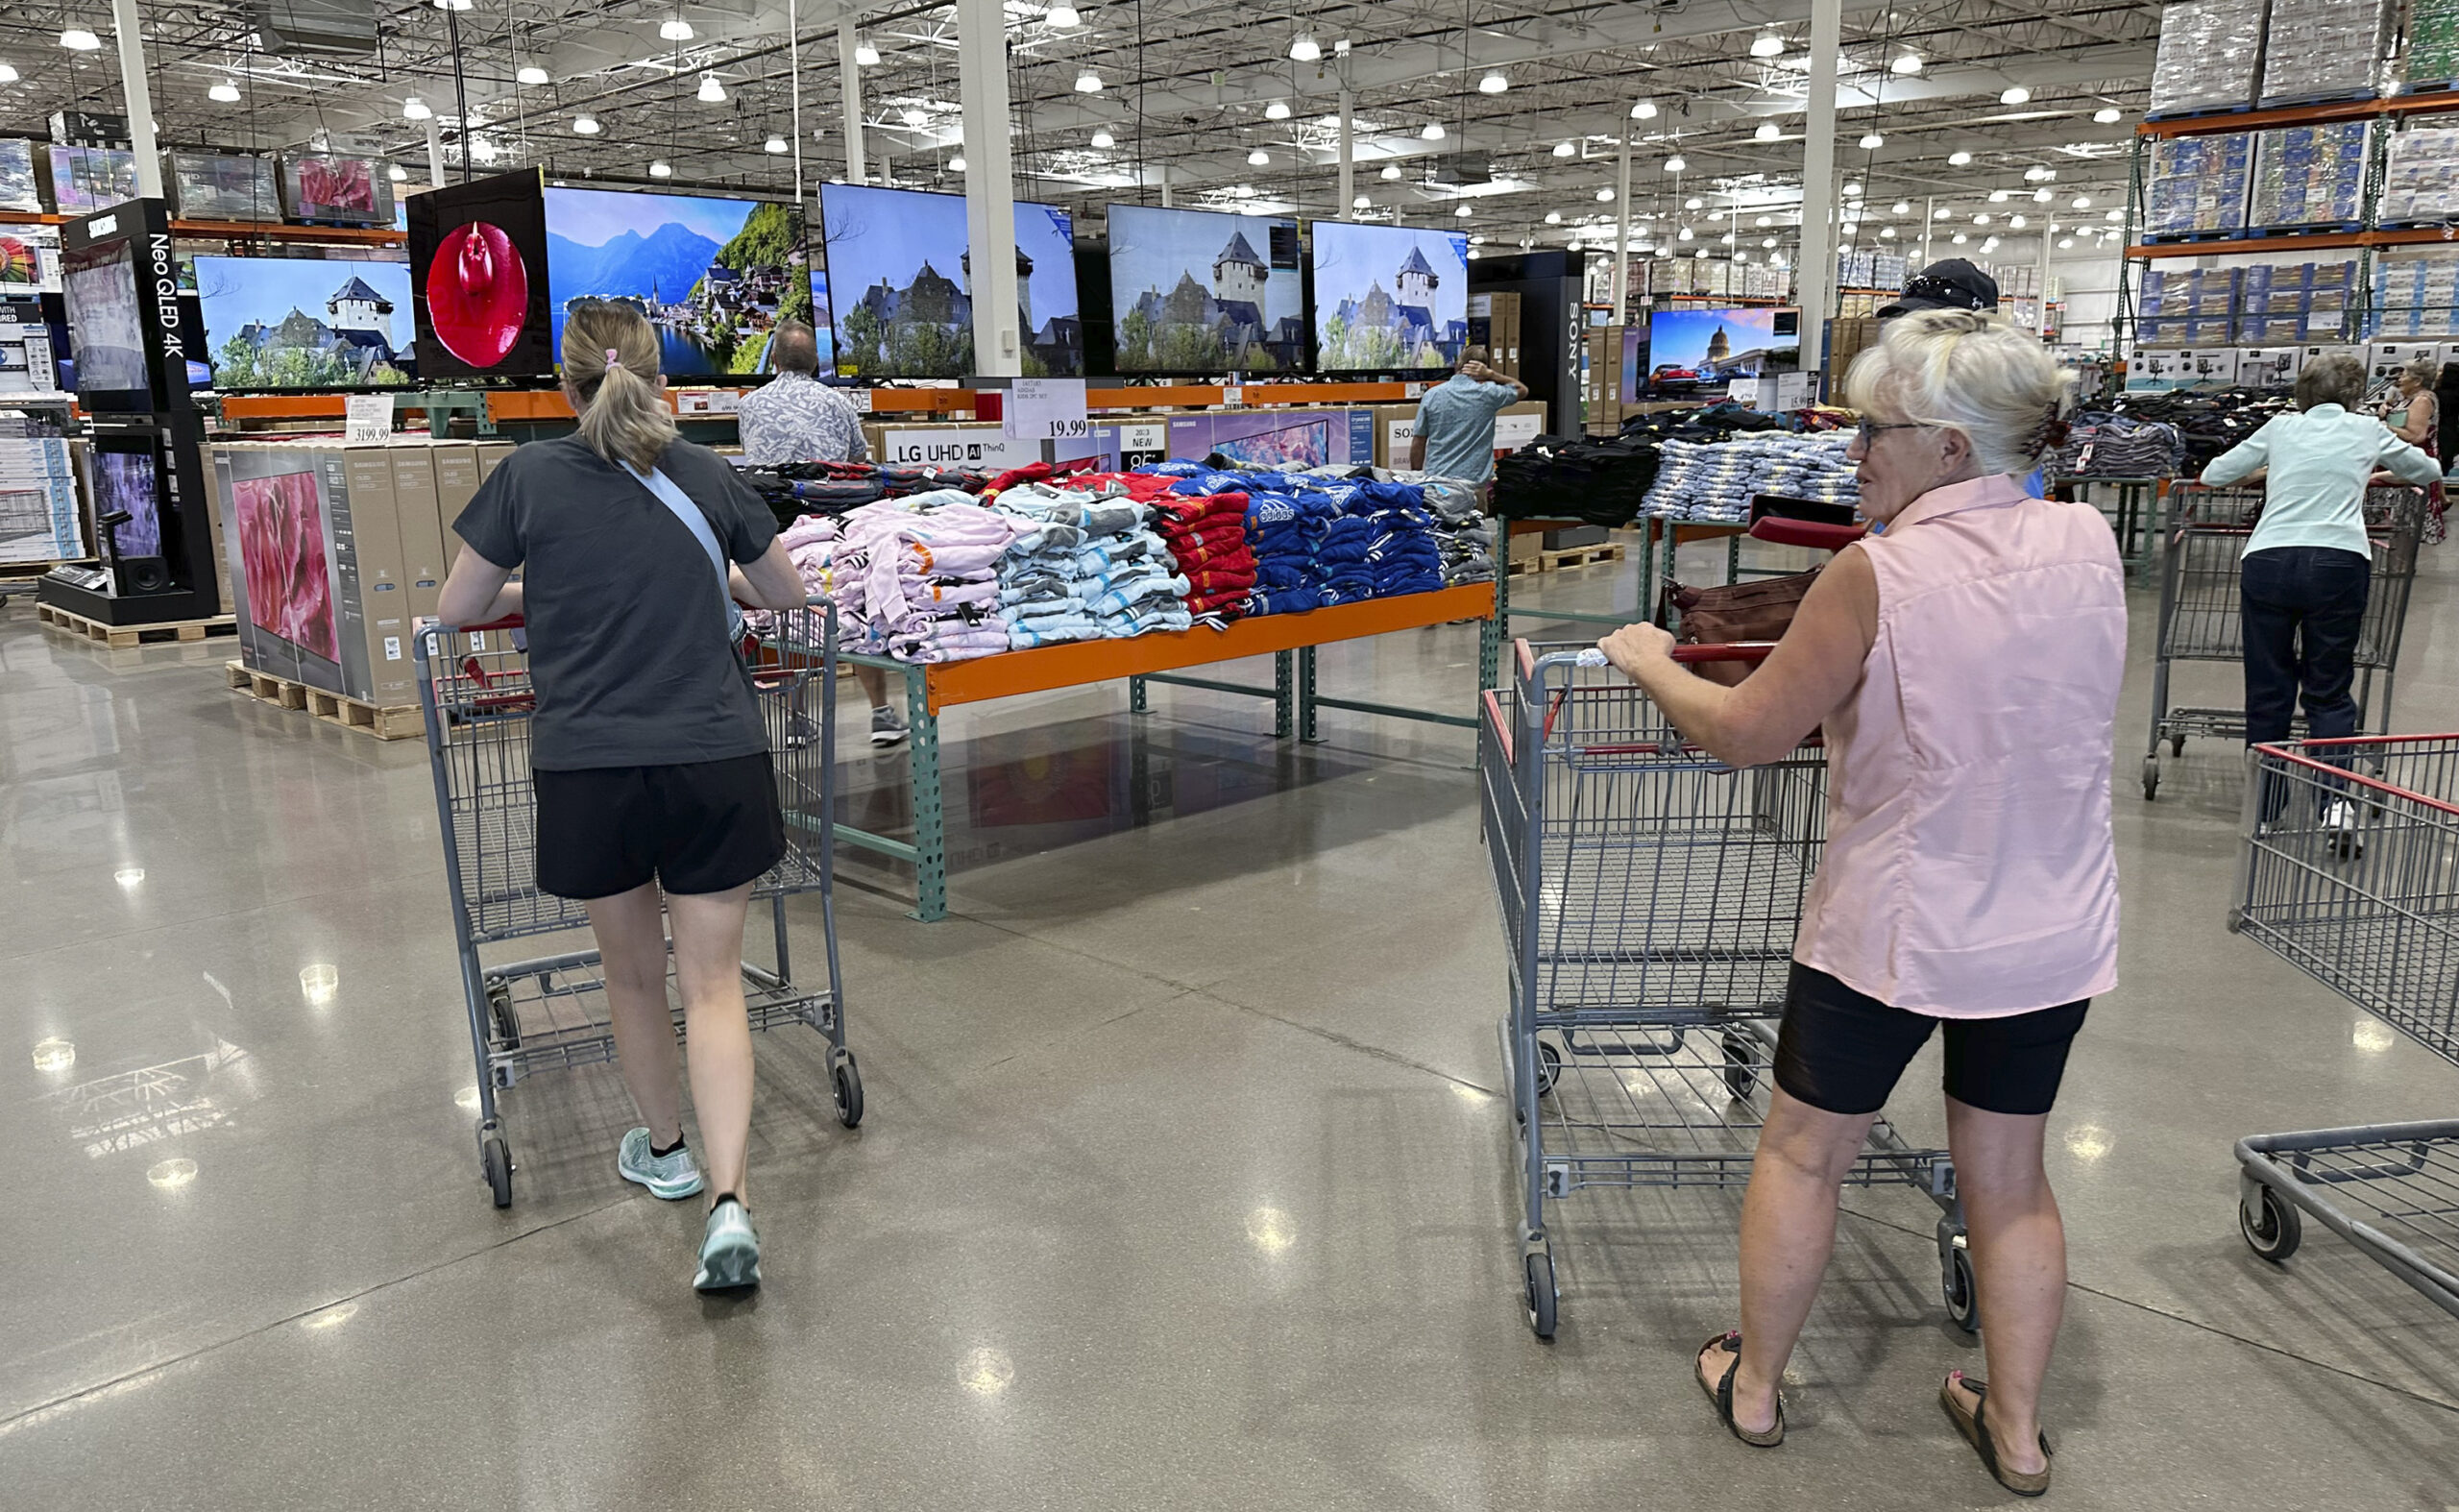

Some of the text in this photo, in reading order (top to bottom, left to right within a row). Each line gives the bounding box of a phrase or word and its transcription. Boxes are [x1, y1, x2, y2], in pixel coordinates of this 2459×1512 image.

[149, 233, 184, 358] Neo QLED 4K
[1568, 302, 1579, 381] SONY
[354, 427, 390, 442] 3199.99
[1049, 419, 1086, 437] 19.99
[1132, 438, 1153, 447] NEW
[898, 443, 1005, 463] LG UHD AI ThinQ
[1259, 507, 1295, 523] adidas
